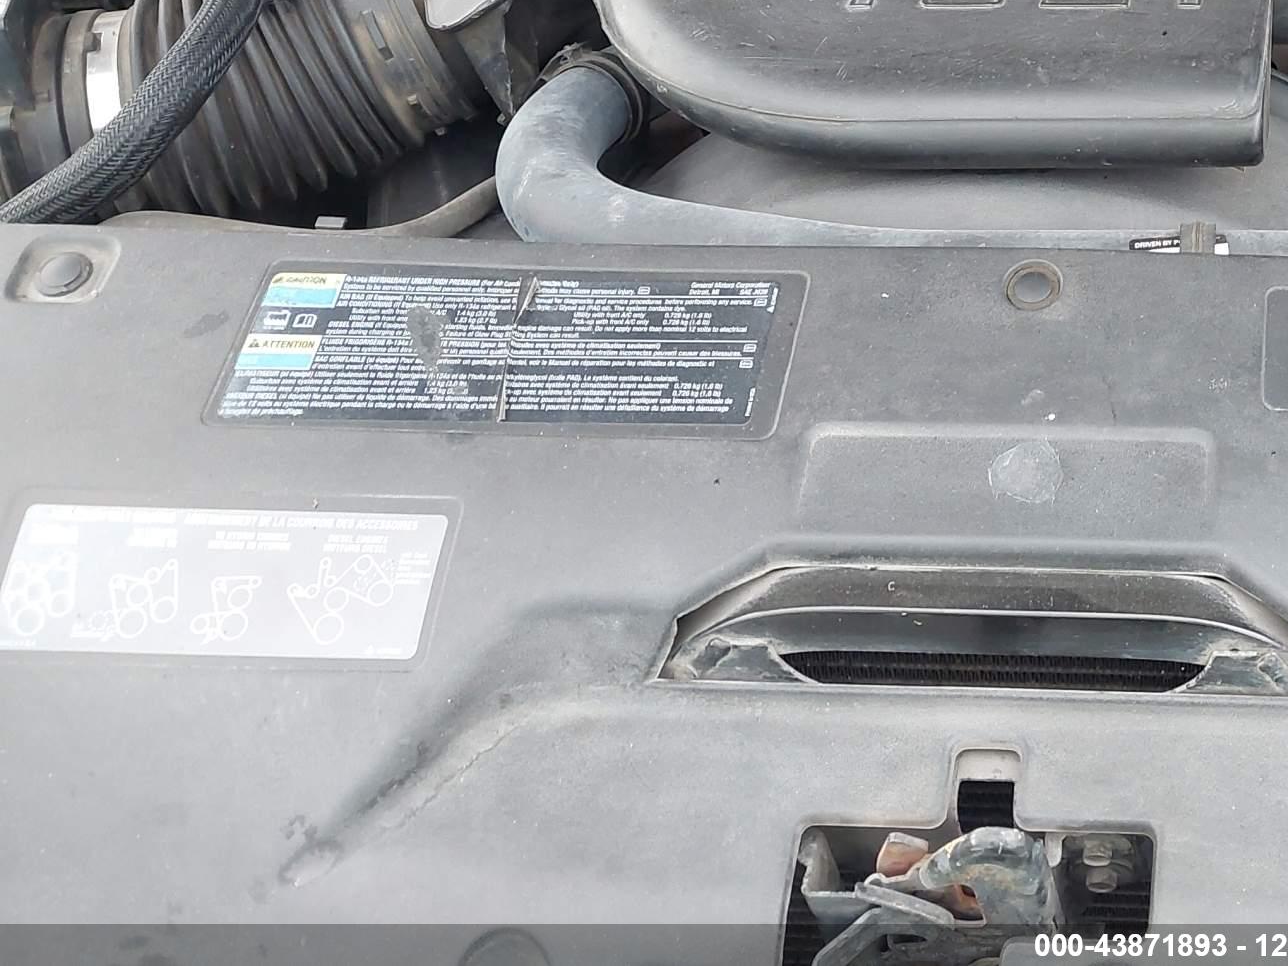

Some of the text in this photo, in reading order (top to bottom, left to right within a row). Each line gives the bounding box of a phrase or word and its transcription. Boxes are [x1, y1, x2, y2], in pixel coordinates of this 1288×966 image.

[1134, 240, 1162, 249] DRIVEN
[1163, 239, 1172, 247] BY
[286, 276, 327, 285] CAUTION
[263, 340, 315, 349] ATTENTION
